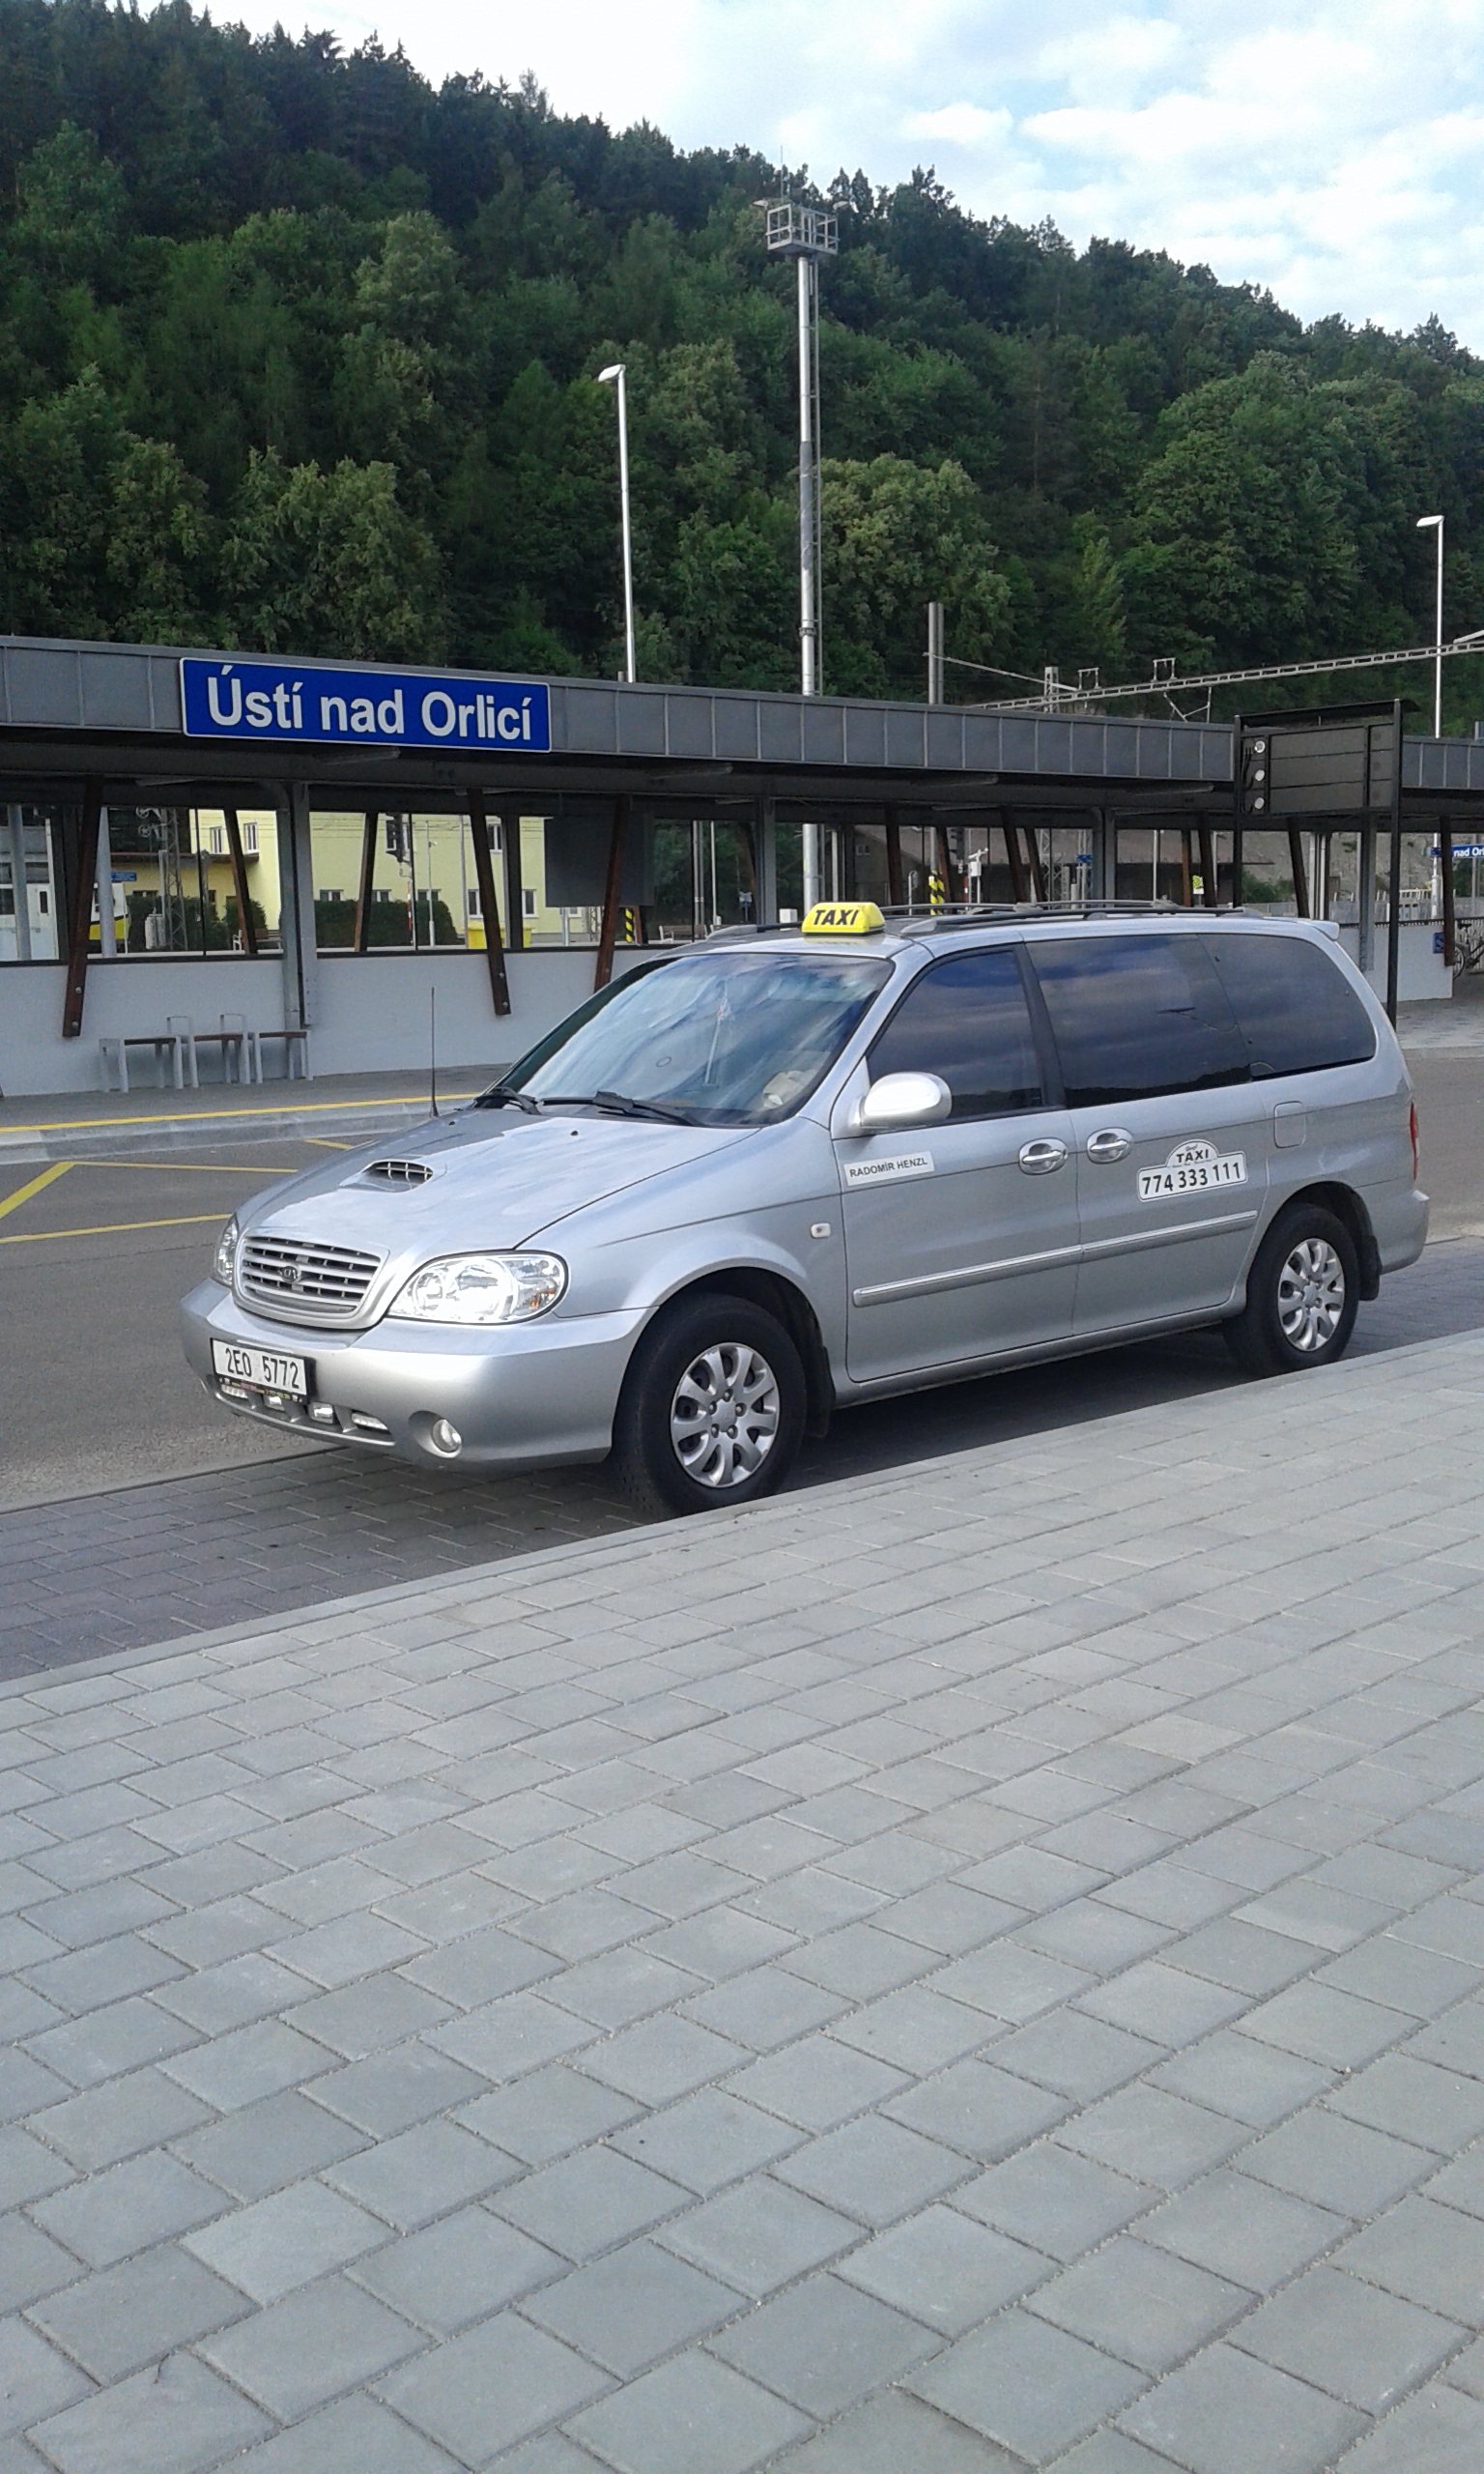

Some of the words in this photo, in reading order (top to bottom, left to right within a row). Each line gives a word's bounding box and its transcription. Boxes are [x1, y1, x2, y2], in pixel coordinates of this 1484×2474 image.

[207, 665, 303, 729] Ústí
[320, 689, 405, 734] nad
[421, 691, 532, 741] Orlicí
[813, 908, 860, 926] TAXI
[897, 1157, 928, 1170] HENZL
[1176, 1148, 1210, 1164] TAXI
[1142, 1174, 1173, 1194] 774
[1178, 1168, 1208, 1188] 333
[1213, 1163, 1241, 1181] 111
[262, 1355, 300, 1389] 5772
